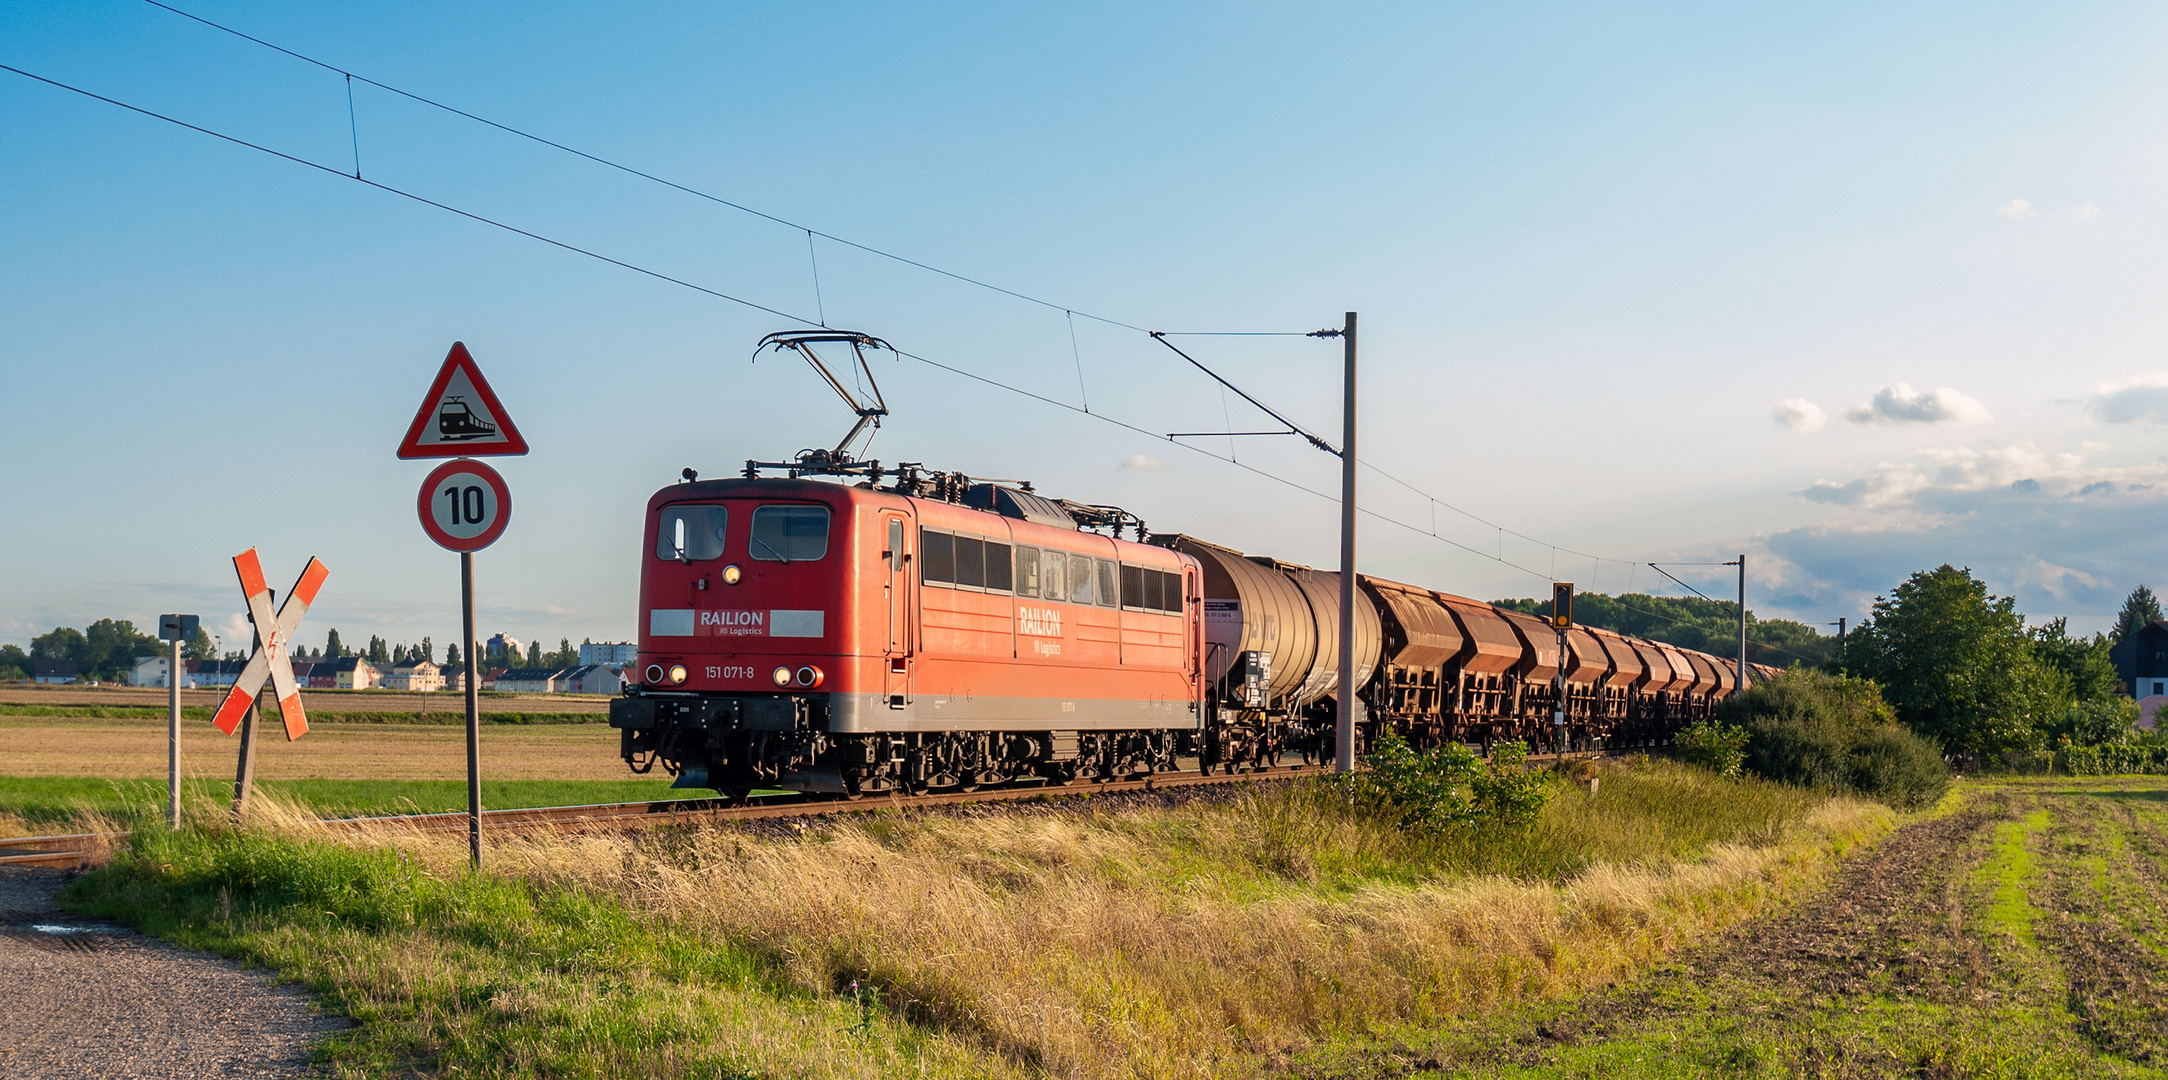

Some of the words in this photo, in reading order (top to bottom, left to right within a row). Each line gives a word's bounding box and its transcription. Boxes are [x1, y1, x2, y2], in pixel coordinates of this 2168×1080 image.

[444, 485, 485, 525] 10
[701, 611, 763, 626] RAILION
[1020, 606, 1061, 637] RAILION
[729, 627, 763, 637] Logistics
[1040, 640, 1061, 658] Logistics
[705, 666, 721, 679] 151
[723, 666, 755, 679] 071-8
